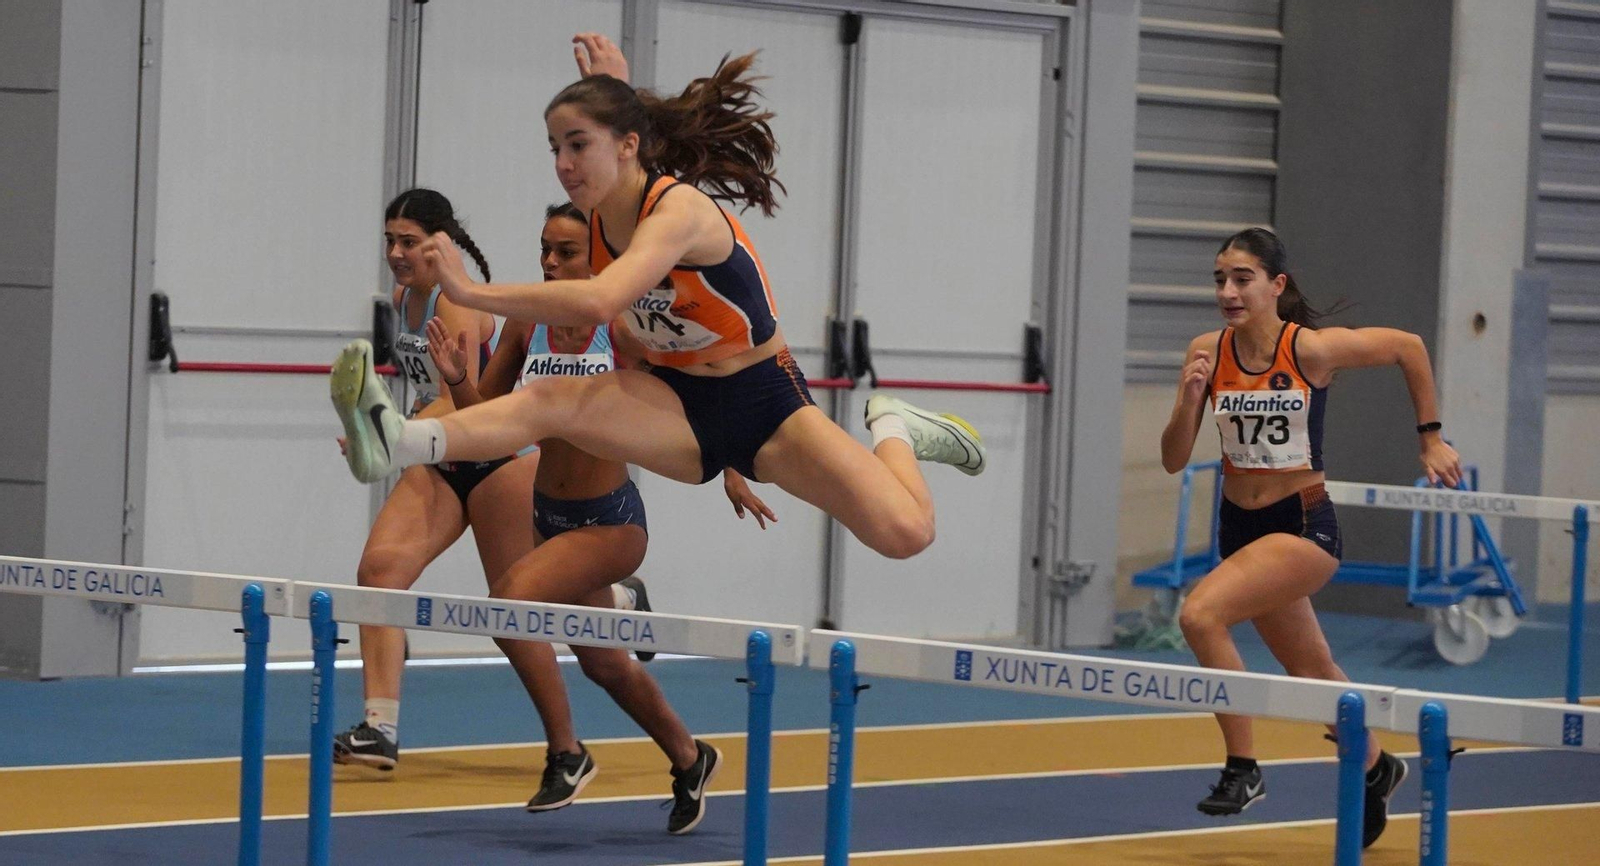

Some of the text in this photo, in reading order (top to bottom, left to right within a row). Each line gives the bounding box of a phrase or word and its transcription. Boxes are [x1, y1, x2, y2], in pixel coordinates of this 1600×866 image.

[404, 355, 432, 384] 49
[525, 357, 608, 376] Atlántico
[1219, 393, 1304, 412] Atlántico
[1229, 415, 1290, 445] 173
[52, 568, 78, 591] DE
[84, 570, 164, 598] GALICIA
[443, 602, 656, 645] XUNTA DE GALICIA
[985, 656, 1230, 706] XUNTA DE GALICIA
